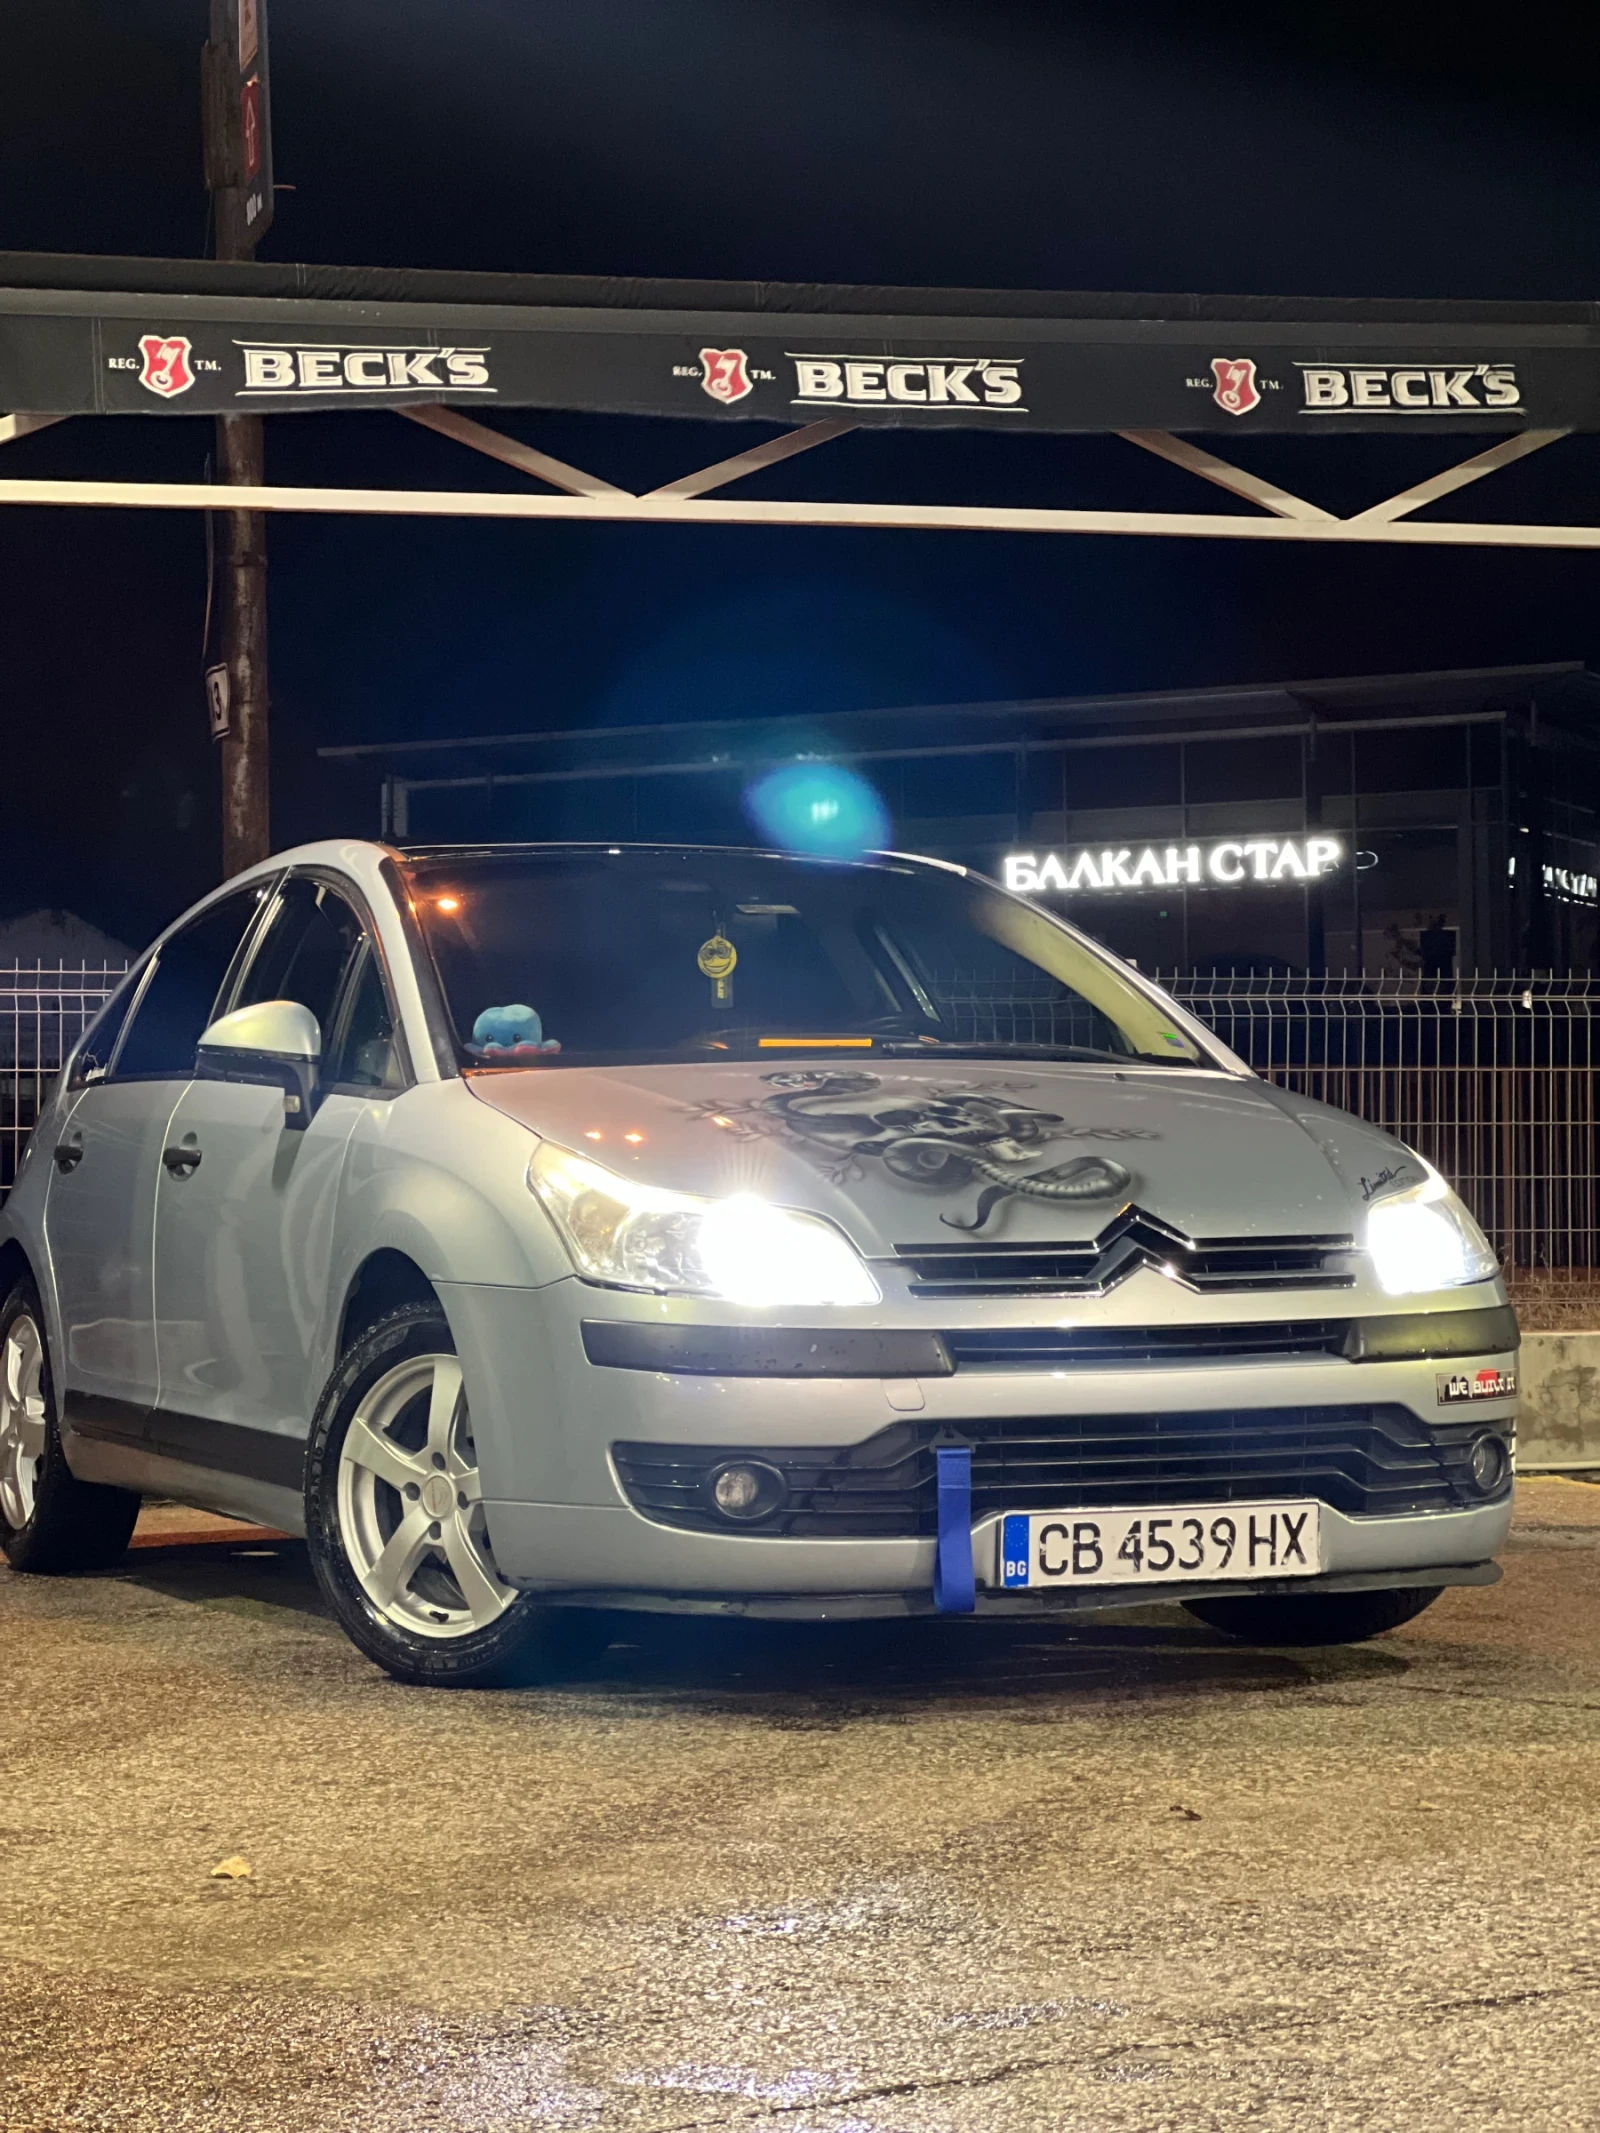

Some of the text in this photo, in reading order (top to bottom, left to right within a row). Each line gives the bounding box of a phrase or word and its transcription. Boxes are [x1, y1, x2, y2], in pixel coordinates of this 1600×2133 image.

[108, 347, 489, 387] REG. TM. BECK'S
[672, 359, 1022, 404] REG. TM. BECK'S
[1185, 364, 1520, 406] REG. TM. BECK'S
[1004, 839, 1341, 891] БАЛКАН СТАР
[1449, 1381, 1468, 1396] WE
[1473, 1377, 1504, 1394] BUILT
[1038, 1512, 1308, 1576] CB 4539 HX
[1005, 1560, 1027, 1577] BG
